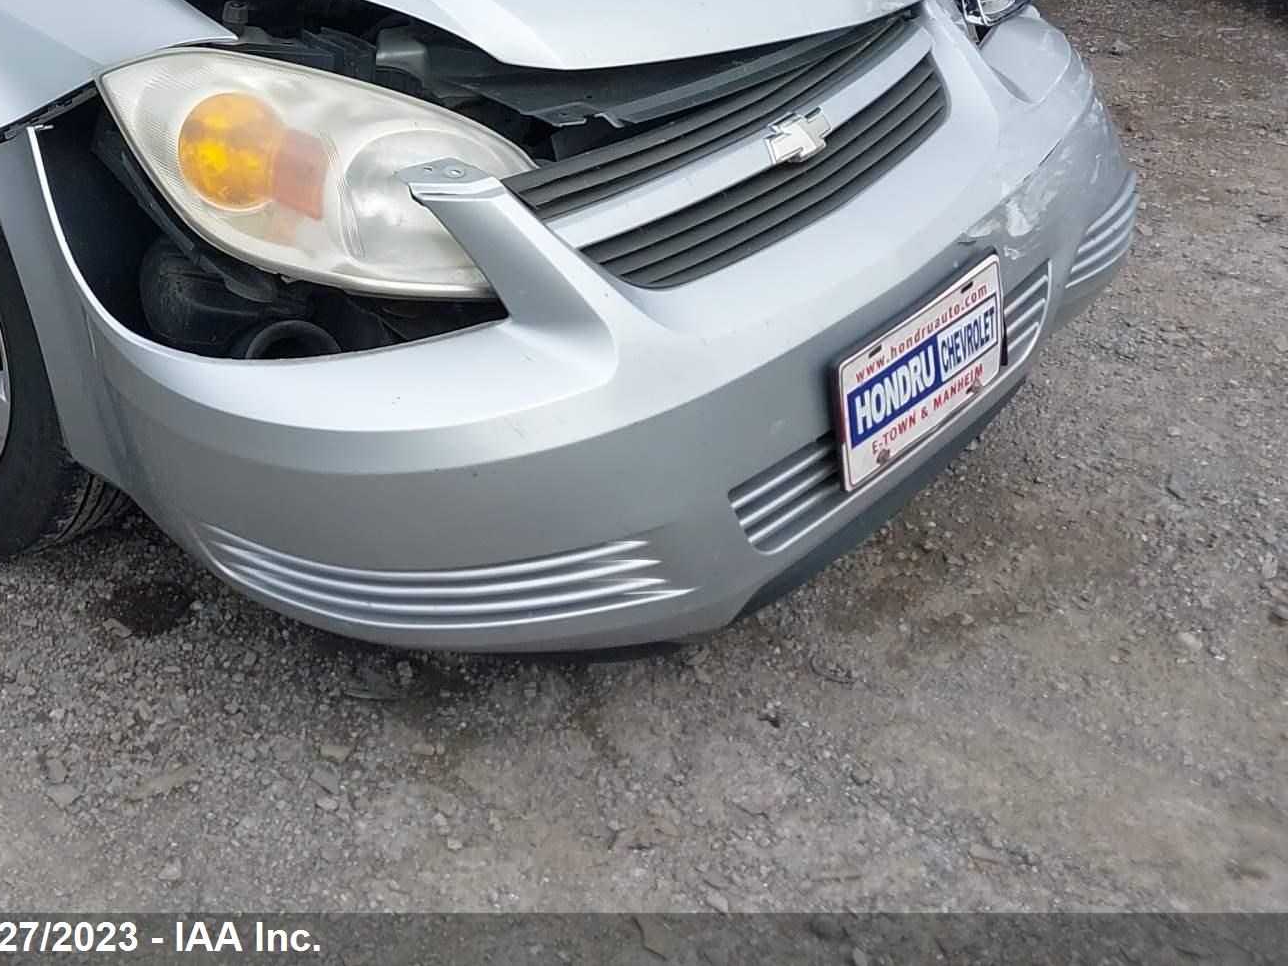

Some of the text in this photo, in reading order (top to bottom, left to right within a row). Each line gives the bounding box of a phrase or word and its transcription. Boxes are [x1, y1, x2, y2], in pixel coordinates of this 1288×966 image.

[854, 305, 997, 436] HONDRU CHEVROLET
[855, 283, 988, 384] www.hondruauto.com
[871, 363, 984, 455] E-TOWN & MANHEIM
